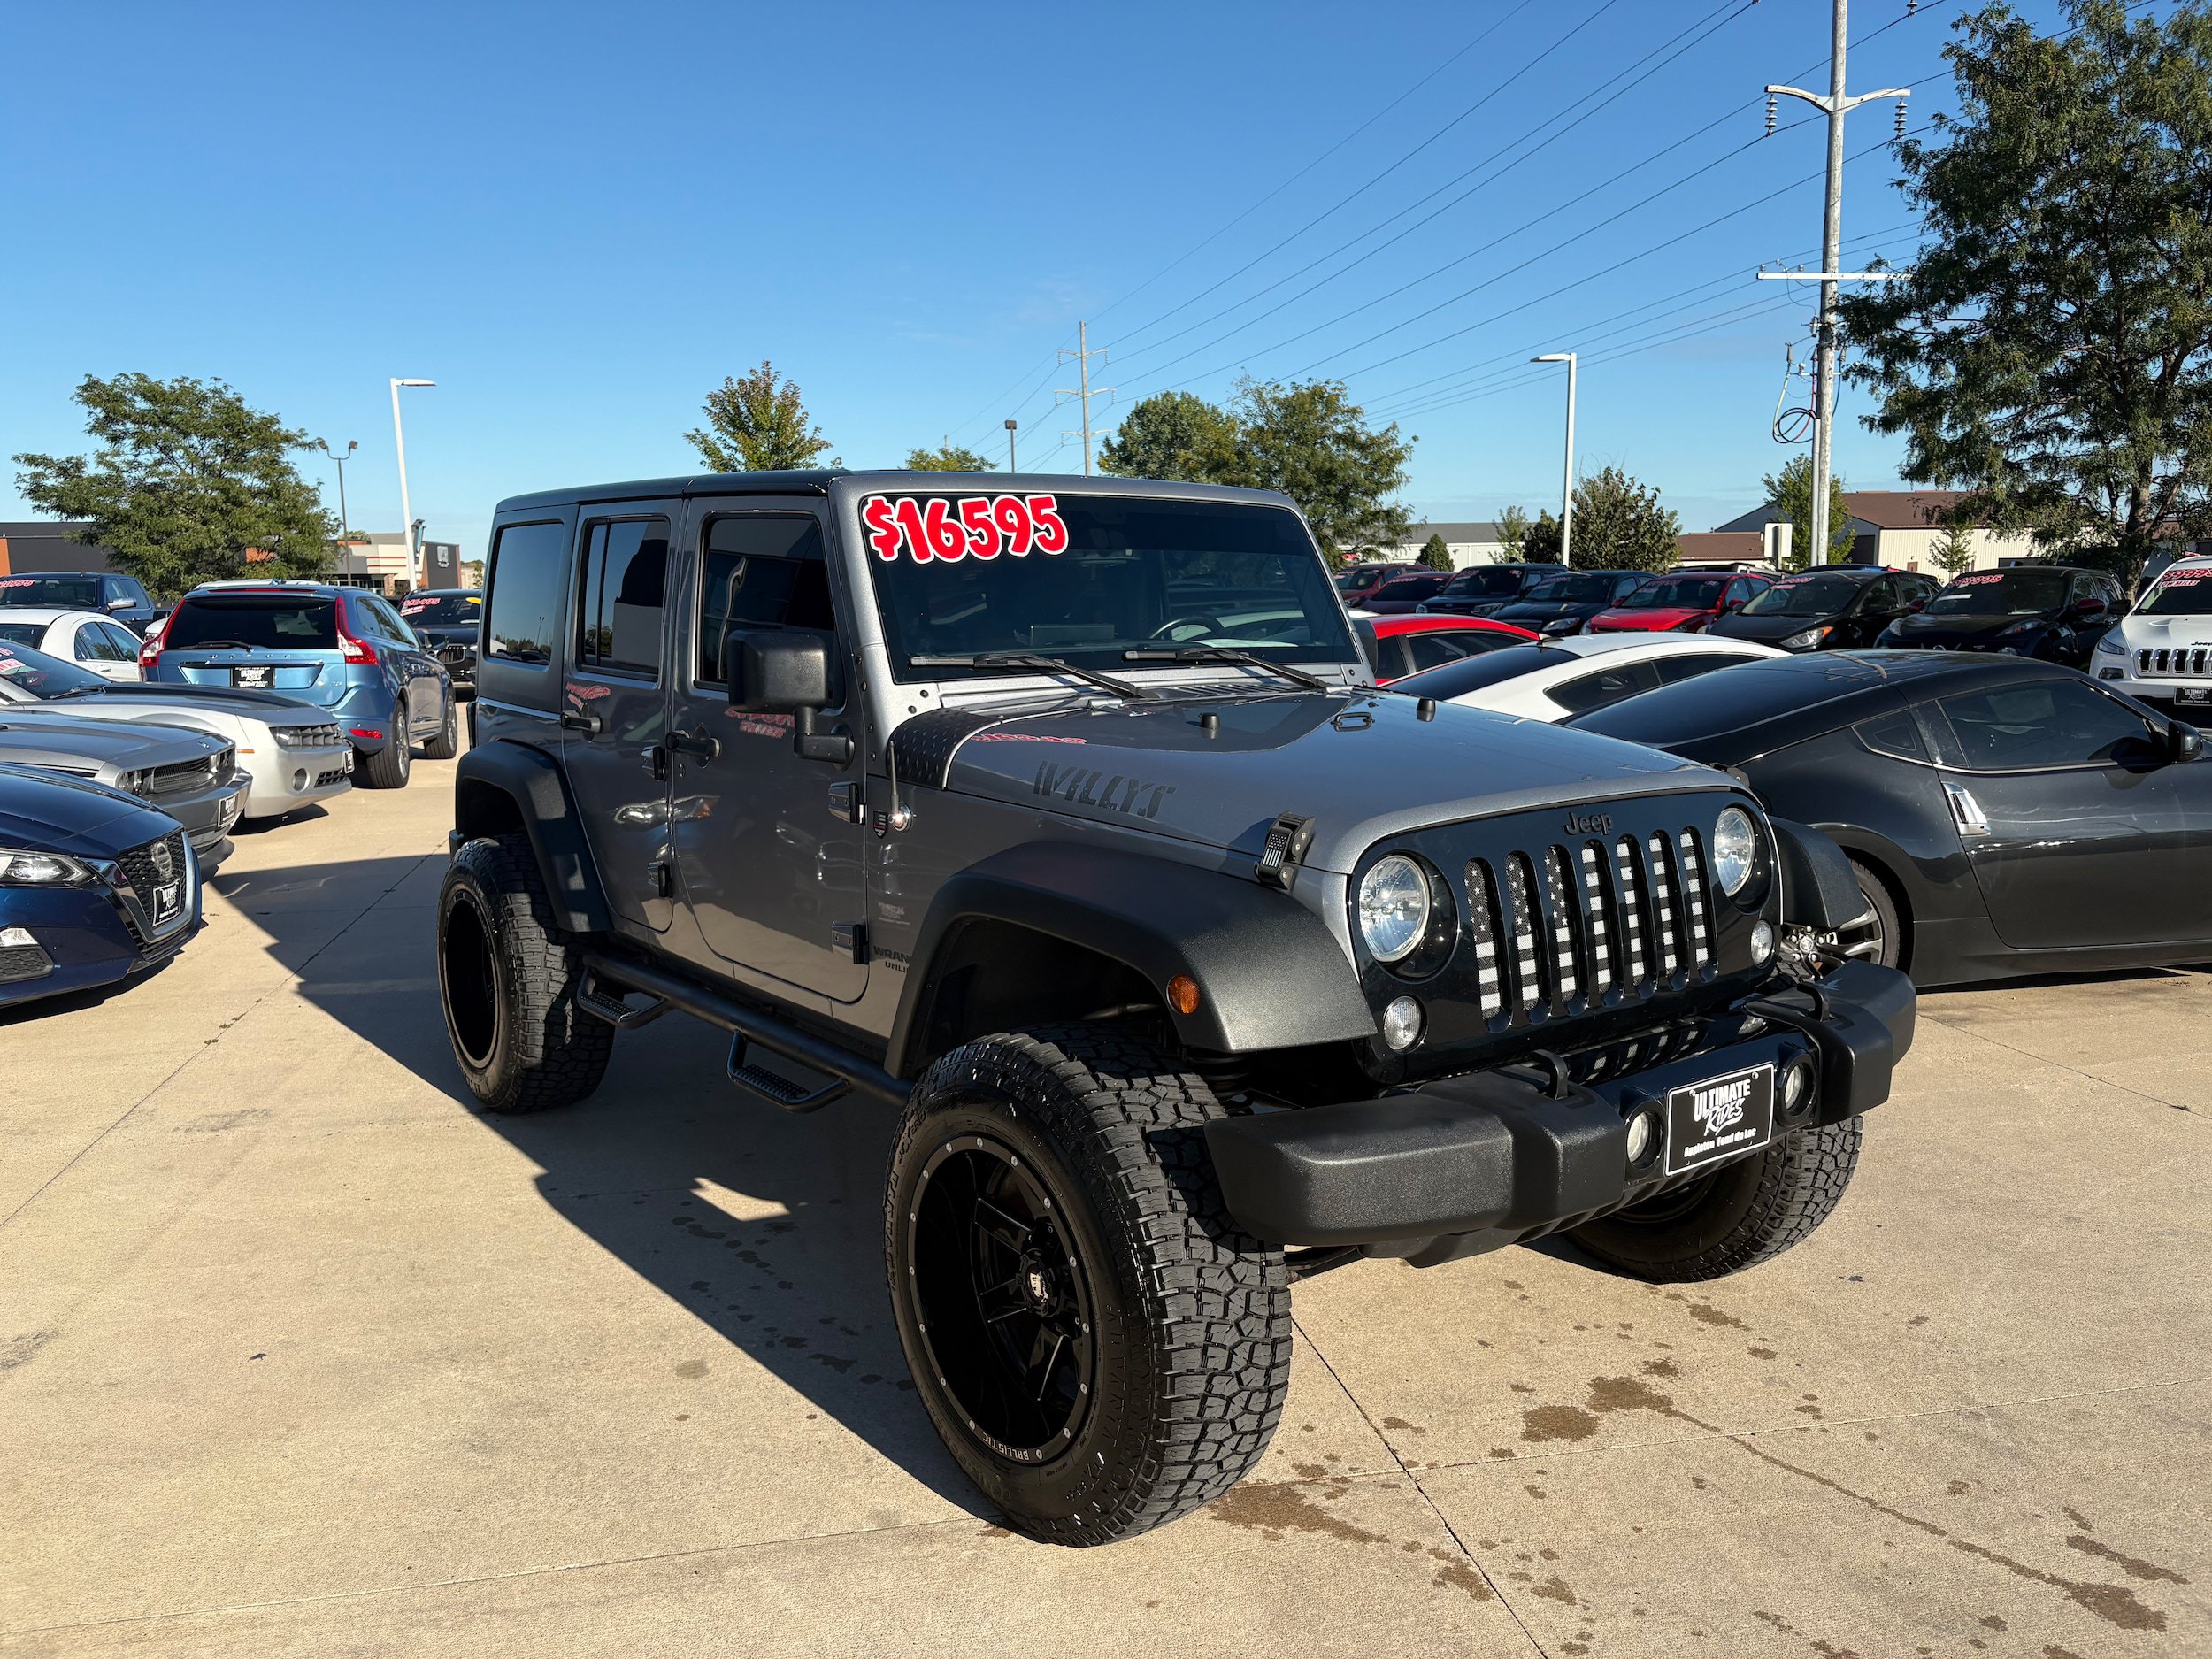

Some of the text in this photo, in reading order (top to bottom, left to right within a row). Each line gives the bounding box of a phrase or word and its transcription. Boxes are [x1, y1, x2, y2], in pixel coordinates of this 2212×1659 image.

[863, 495, 1069, 564] $16595
[1033, 760, 1176, 818] WILLYS
[1563, 812, 1614, 835] Jeep
[885, 961, 908, 973] UNLI
[1694, 1079, 1751, 1122] ULTIMATE
[1703, 1097, 1746, 1136] RIDES
[1684, 1140, 1716, 1157] Appleton
[1717, 1133, 1734, 1147] Fond
[1744, 1128, 1757, 1138] Lac
[982, 1432, 1030, 1461] BALLISTIC
